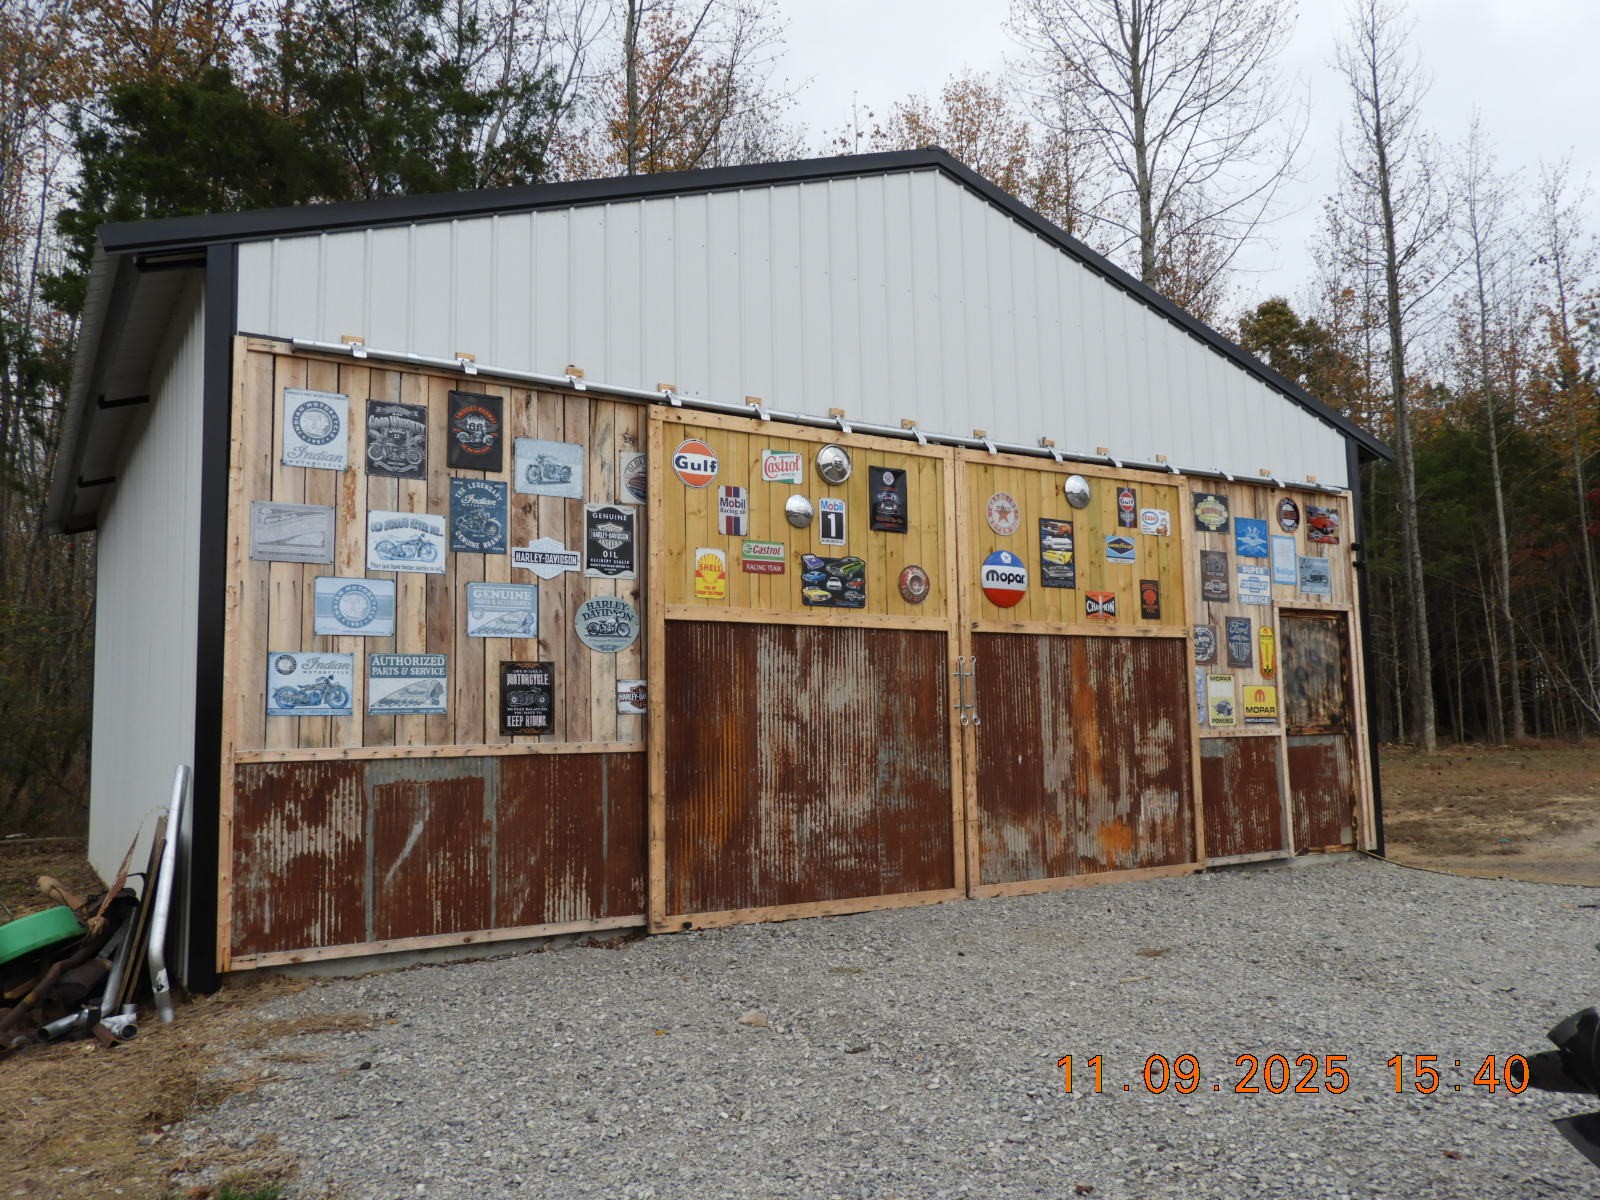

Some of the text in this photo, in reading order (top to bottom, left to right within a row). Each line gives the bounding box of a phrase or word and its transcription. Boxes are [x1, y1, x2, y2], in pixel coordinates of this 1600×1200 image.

[287, 445, 344, 463] Indian
[674, 455, 717, 473] Gulf
[764, 455, 800, 479] Castrol
[455, 482, 503, 501] THE LEGENDARY
[461, 494, 497, 506] Indian
[720, 497, 746, 509] Mobil
[821, 500, 843, 512] Mobil
[592, 512, 627, 521] GENUINE
[828, 513, 836, 537] 1
[455, 530, 480, 549] GENUINE
[592, 531, 629, 540] HARLEY-DAVIDSON
[602, 550, 619, 559] OIL
[752, 544, 780, 556] Castrol
[515, 552, 577, 565] HARLEY-DAVIDSON
[746, 563, 781, 572] RACING TEAM
[1242, 566, 1264, 574] SUPER
[473, 589, 532, 600] GENUINE
[582, 608, 634, 622] DAVIDSON
[1229, 621, 1249, 634] Ford
[301, 656, 351, 670] Indian
[372, 656, 445, 666] AUTHORIZED
[372, 667, 445, 675] PARTS & SERVICE
[507, 715, 523, 727] KEEP
